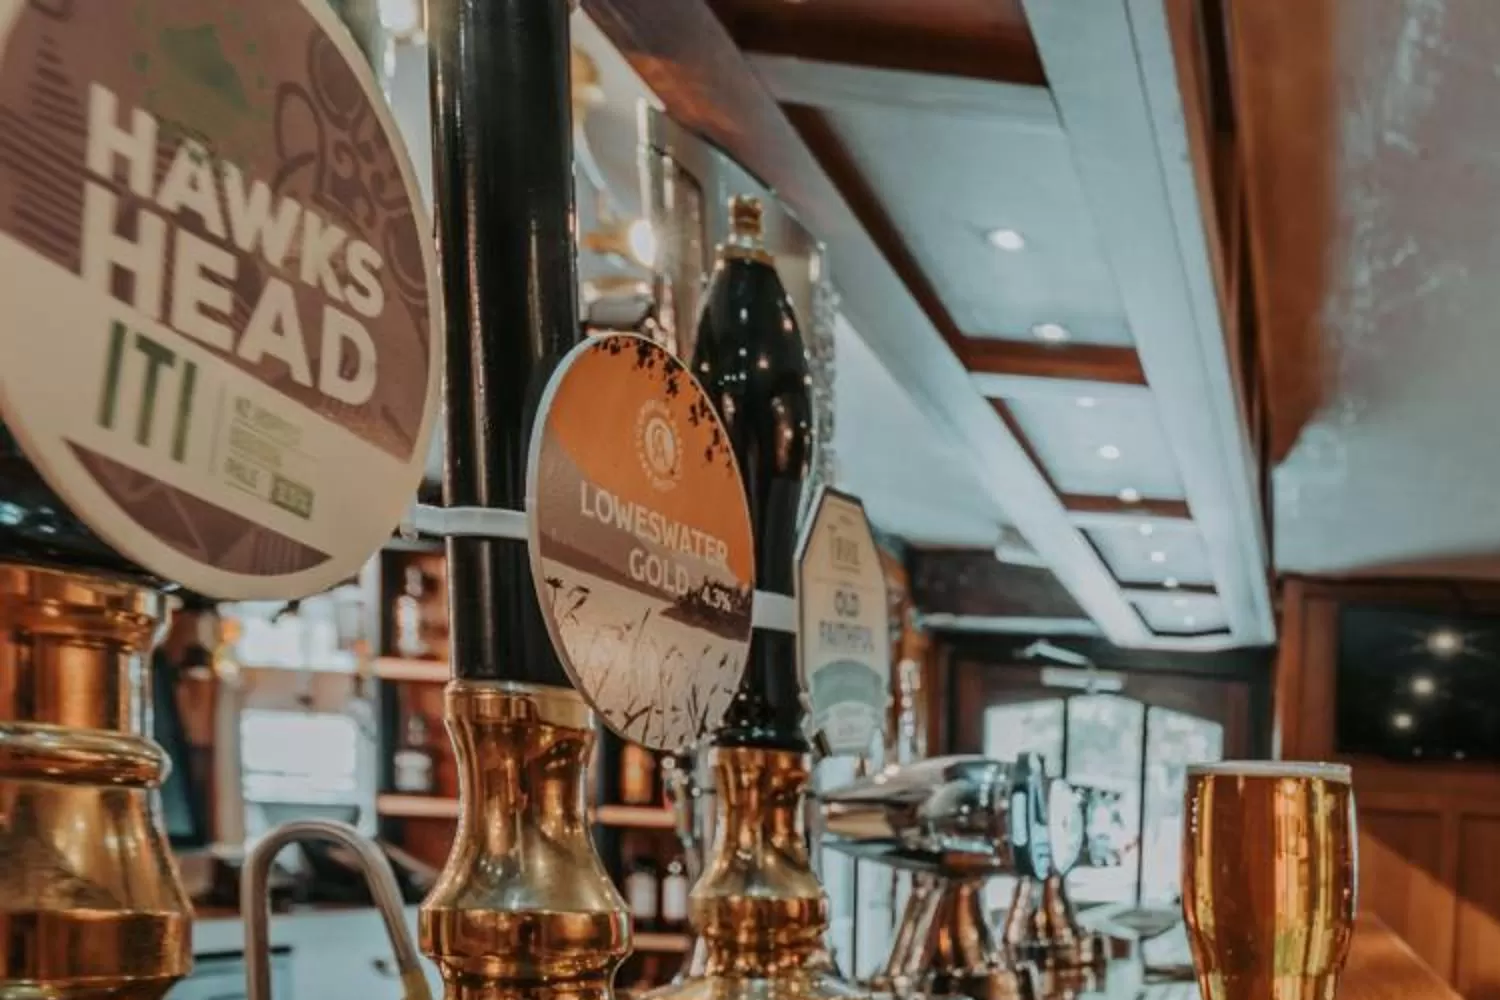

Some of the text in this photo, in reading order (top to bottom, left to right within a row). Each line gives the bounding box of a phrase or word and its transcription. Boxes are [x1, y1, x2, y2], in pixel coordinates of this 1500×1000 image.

[86, 80, 384, 318] HAWKS
[81, 179, 378, 406] HEAD
[97, 319, 198, 464] ITI
[580, 479, 729, 562] LOWESWATER
[629, 547, 689, 597] GOLD
